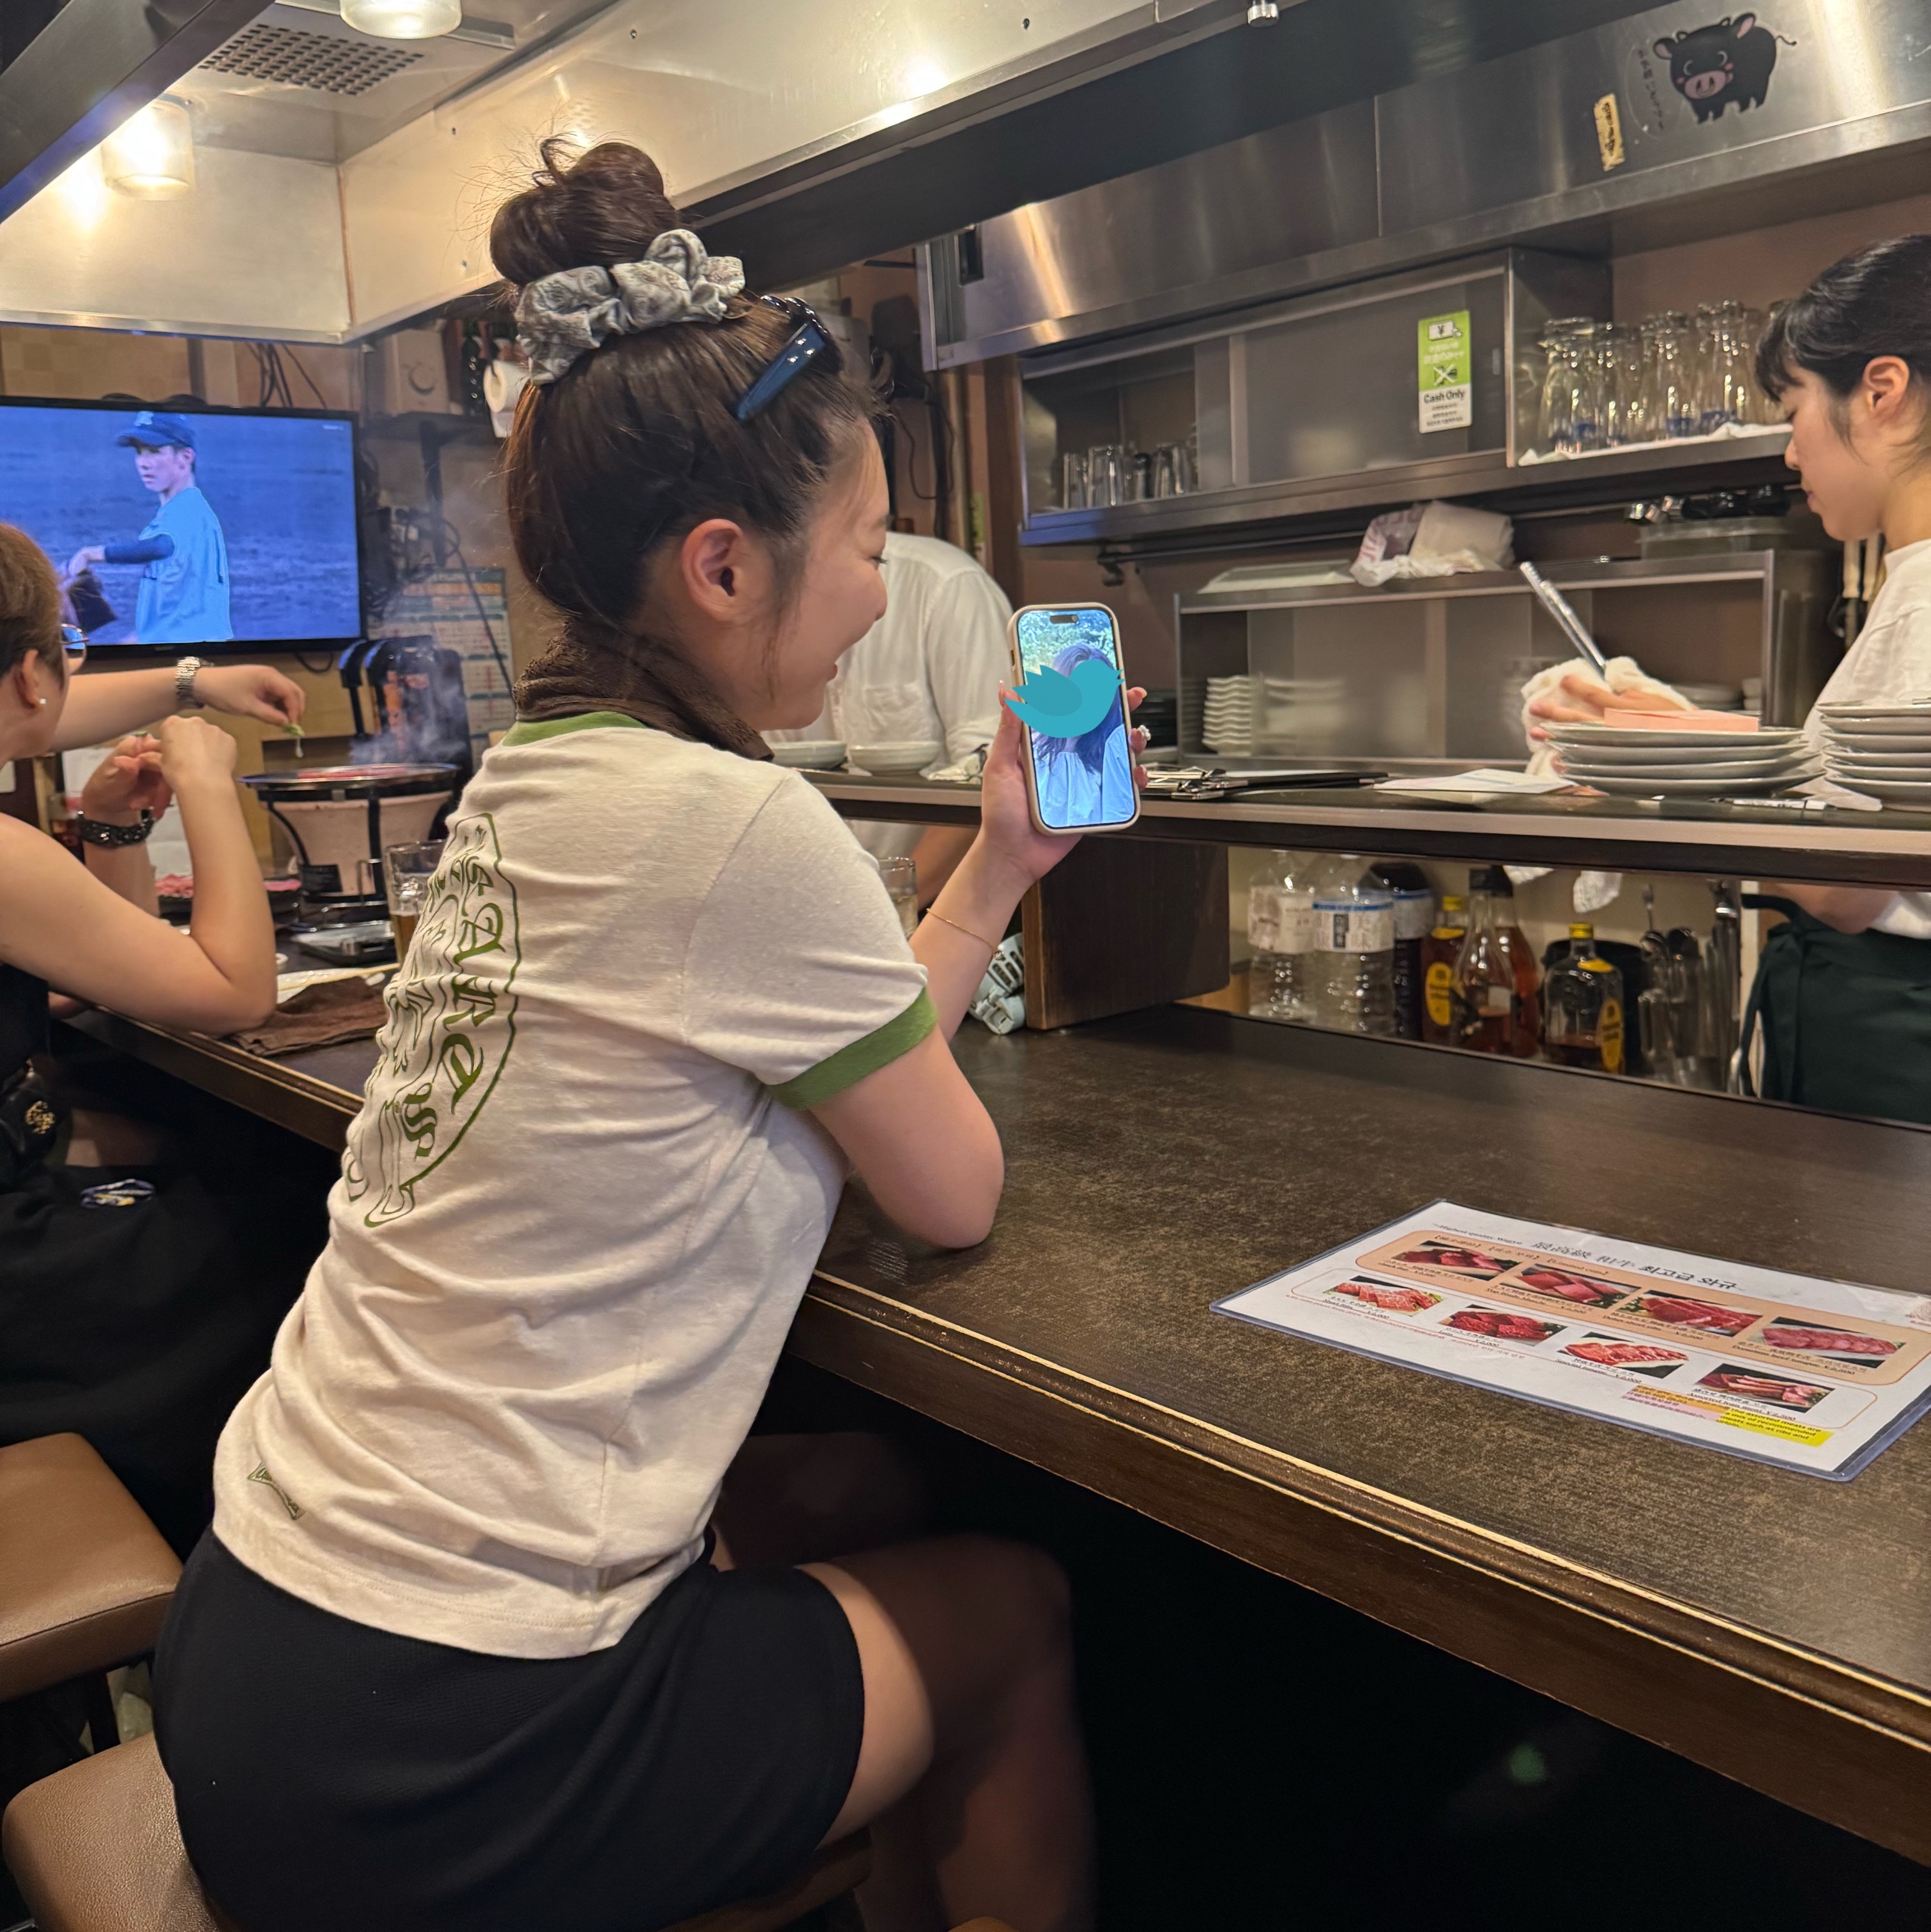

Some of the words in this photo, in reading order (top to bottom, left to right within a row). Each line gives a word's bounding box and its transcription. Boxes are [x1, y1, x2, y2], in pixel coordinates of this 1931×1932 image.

[1423, 391, 1444, 404] Cash
[1446, 389, 1465, 401] Only
[1638, 1263, 1695, 1281] 최고급
[1771, 1352, 1792, 1361] beef
[1720, 1415, 1744, 1424] meats
[1746, 1411, 1781, 1422] assorted
[1781, 1419, 1806, 1430] meats
[1758, 1419, 1817, 1436] recommended
